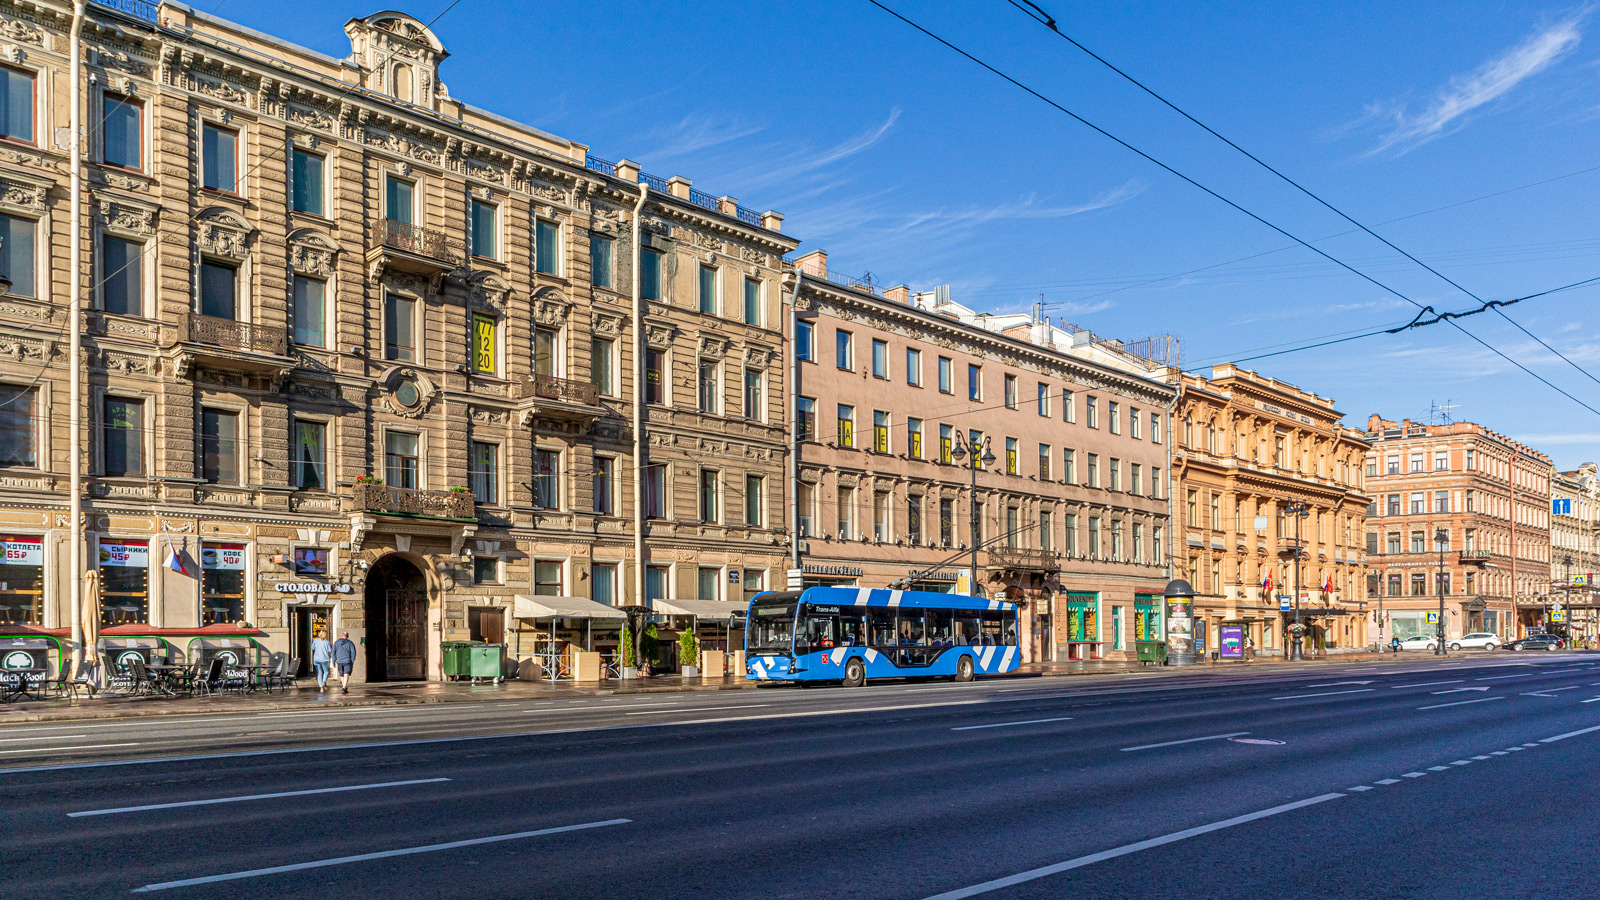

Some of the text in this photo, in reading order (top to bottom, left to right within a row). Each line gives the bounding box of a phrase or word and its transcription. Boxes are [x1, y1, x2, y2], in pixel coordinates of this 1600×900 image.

[474, 318, 493, 336] 777
[478, 335, 490, 352] 12
[477, 352, 490, 369] 20
[7, 543, 42, 551] КОТЛЕТА
[111, 546, 148, 554] СЫРНИКИ
[274, 582, 332, 593] СТОЛОВАЯ
[1066, 594, 1096, 604] SOUVENIRS
